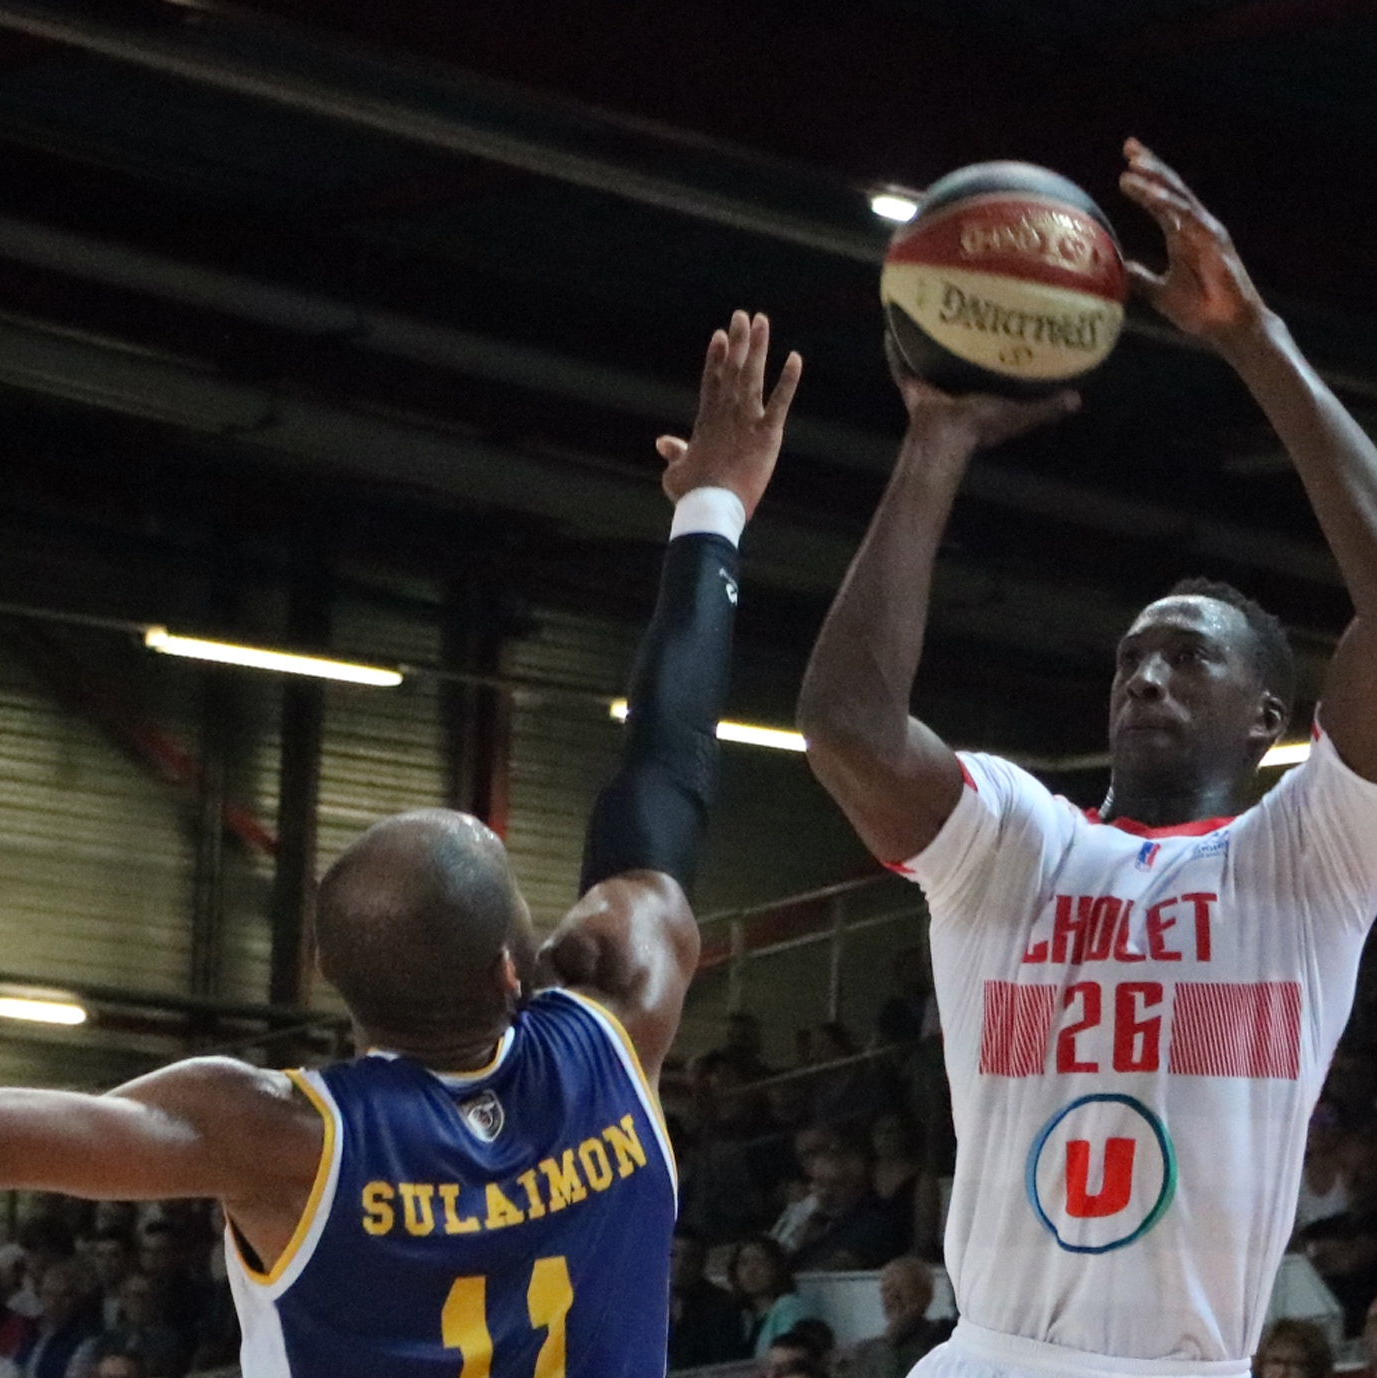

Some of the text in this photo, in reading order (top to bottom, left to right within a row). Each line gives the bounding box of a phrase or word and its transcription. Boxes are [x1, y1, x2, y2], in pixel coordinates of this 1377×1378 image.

[1055, 980, 1164, 1074] 26
[361, 1114, 648, 1238] SULAIMON
[1065, 1137, 1137, 1219] U
